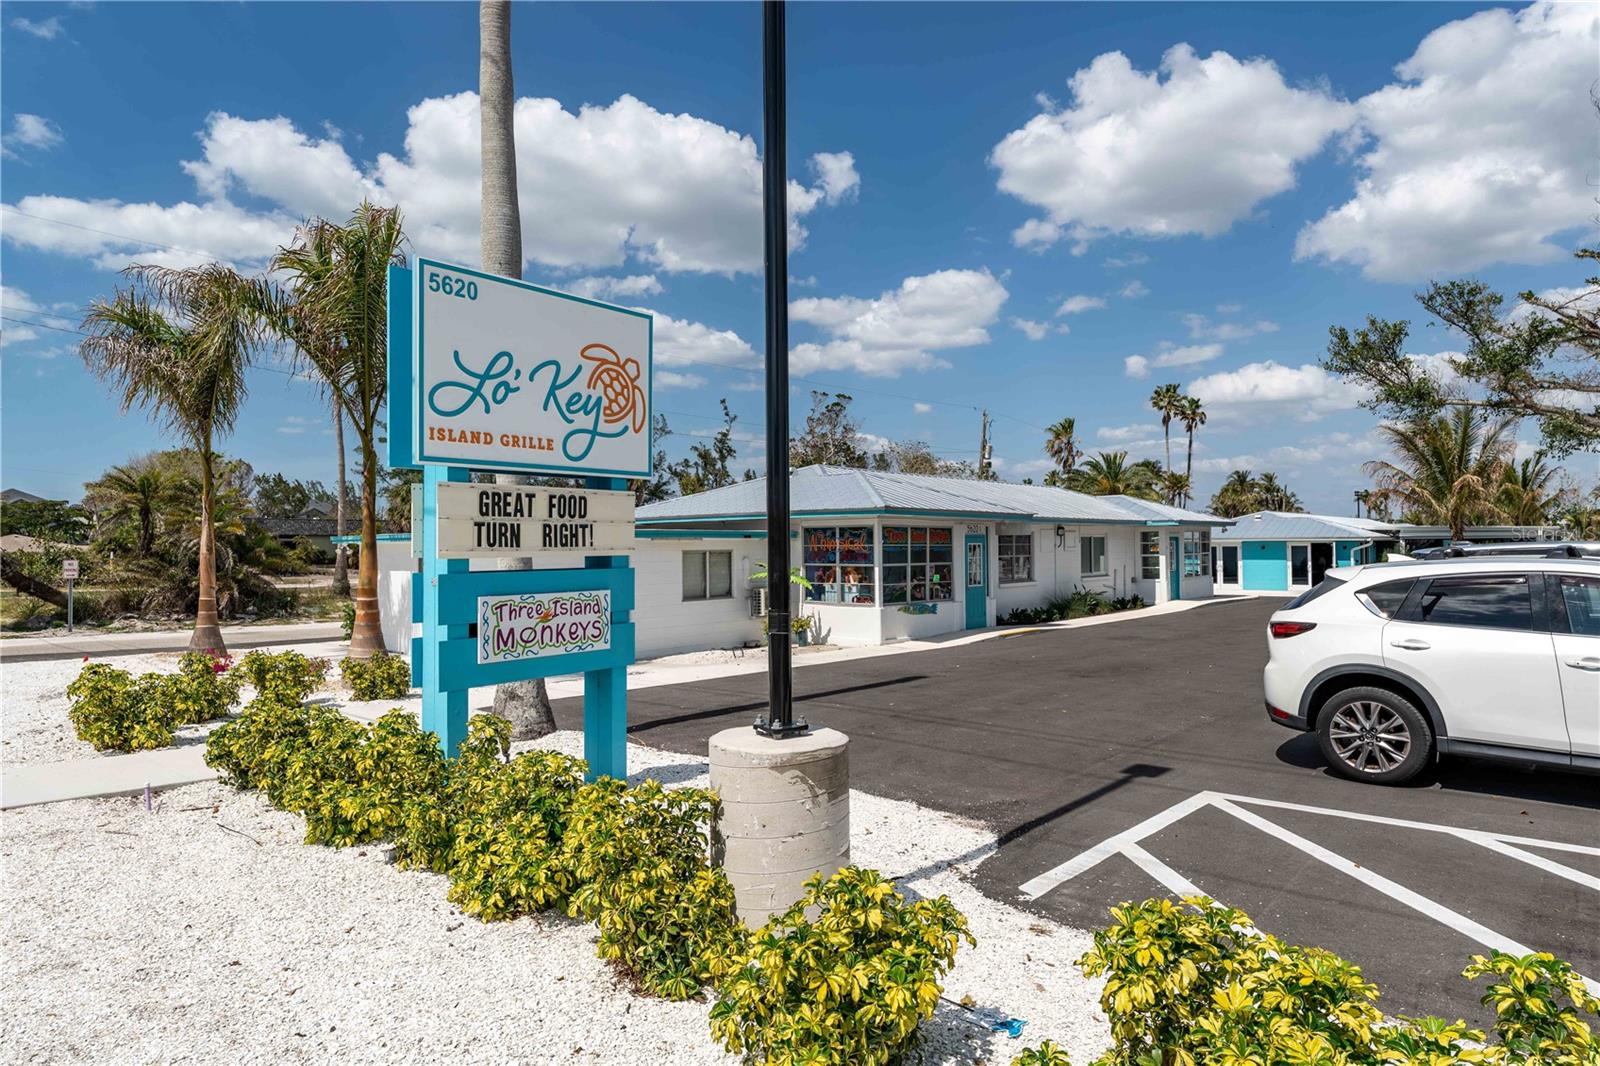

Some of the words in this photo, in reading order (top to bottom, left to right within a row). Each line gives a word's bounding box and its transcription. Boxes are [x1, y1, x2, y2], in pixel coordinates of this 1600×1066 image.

[429, 272, 478, 300] 5620
[529, 360, 629, 462] Key
[428, 426, 494, 445] ISLAND
[500, 434, 555, 451] GRILLE
[478, 491, 536, 517] GREAT
[549, 494, 588, 519] FOOD
[474, 522, 521, 548] TURN
[542, 524, 593, 548] RIGHT!
[494, 601, 544, 623] Three
[551, 596, 601, 617] Island
